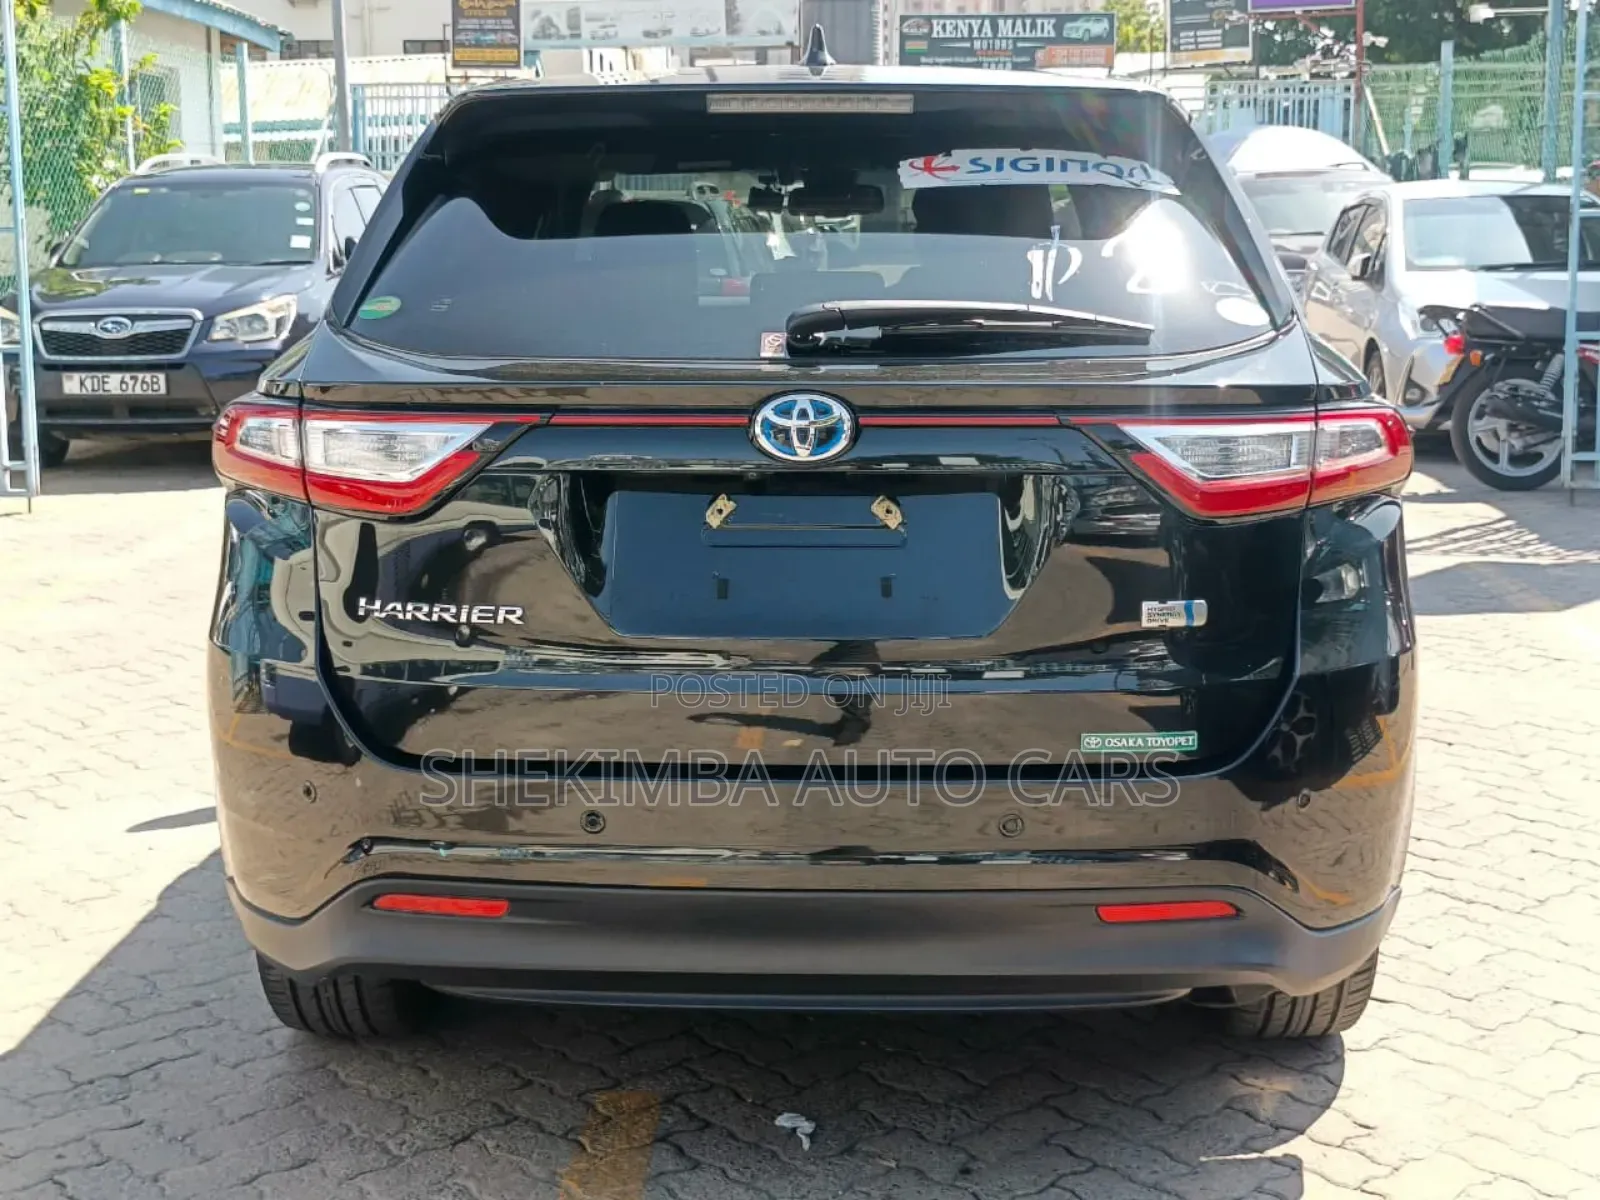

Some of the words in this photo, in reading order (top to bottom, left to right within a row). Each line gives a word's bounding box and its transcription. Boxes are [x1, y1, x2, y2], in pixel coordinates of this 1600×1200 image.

[931, 18, 993, 38] KENYA
[998, 17, 1056, 38] MALIK
[973, 39, 1014, 50] MOTORS
[79, 375, 112, 393] KDE
[119, 374, 161, 393] 676B
[357, 597, 525, 625] HARRIER
[1105, 737, 1144, 747] OSAKA
[1145, 735, 1195, 747] TOYOPET
